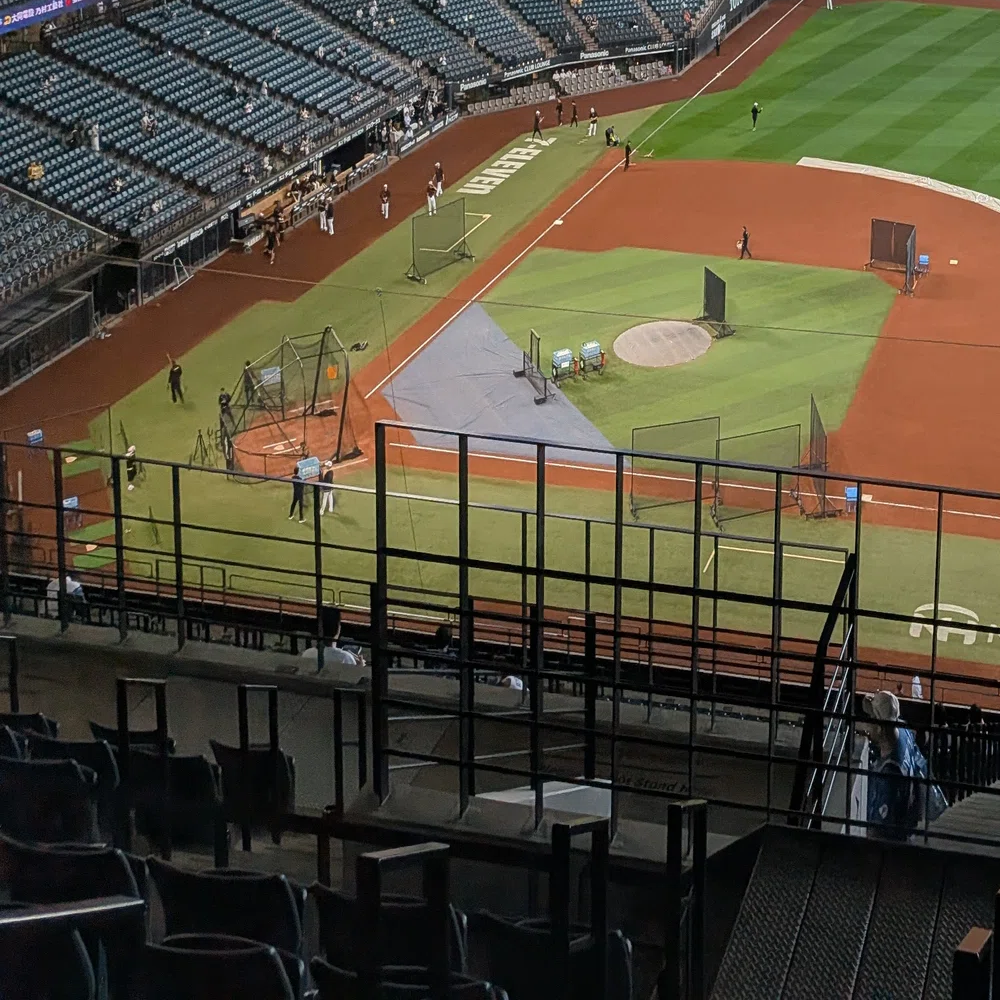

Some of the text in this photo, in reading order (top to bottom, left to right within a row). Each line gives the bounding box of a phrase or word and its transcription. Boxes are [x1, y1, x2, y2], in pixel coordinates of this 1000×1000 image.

[580, 49, 610, 60] Panasonic
[503, 69, 524, 78] Panasonic
[534, 60, 551, 71] LOUNGE
[459, 78, 487, 92] Panasonic
